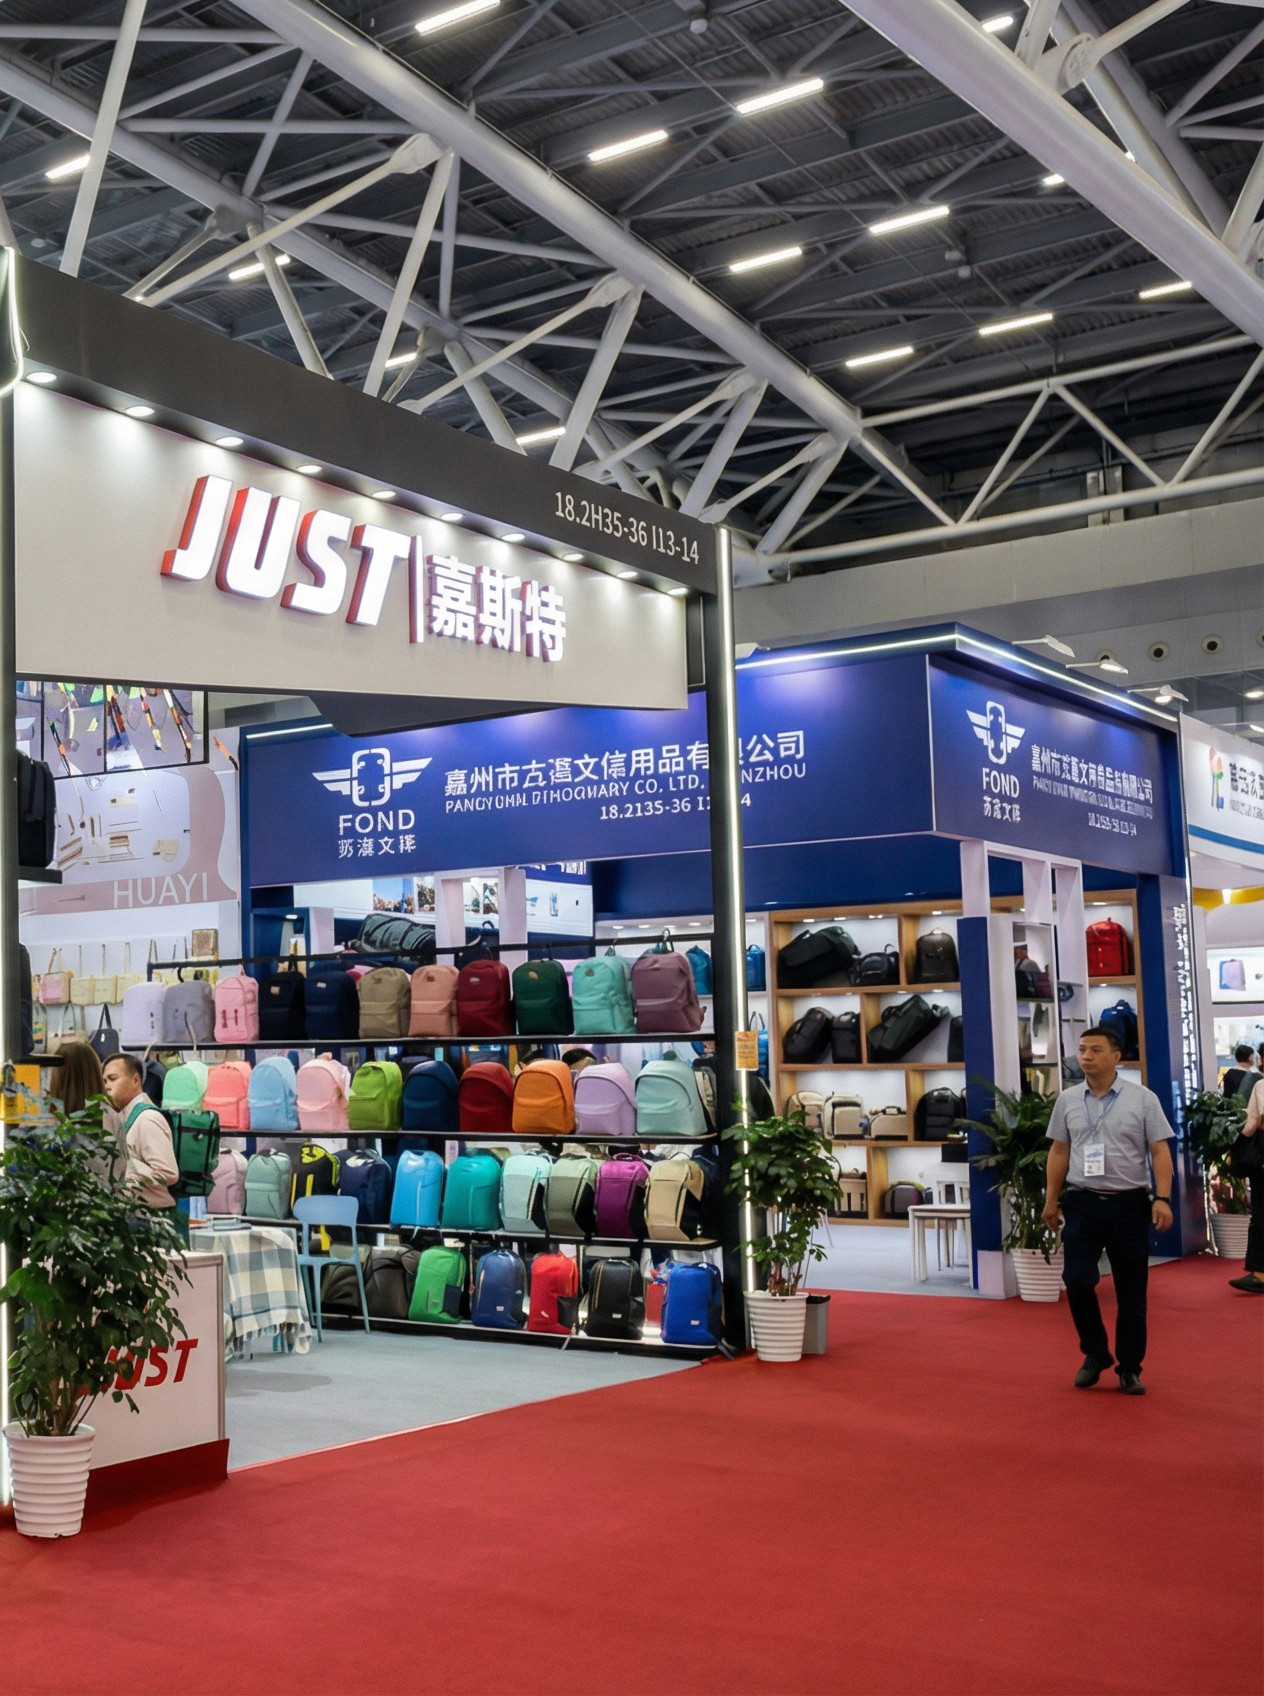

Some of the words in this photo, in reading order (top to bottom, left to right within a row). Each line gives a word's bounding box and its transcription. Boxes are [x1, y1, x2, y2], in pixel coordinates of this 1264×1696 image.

[554, 491, 648, 546] 18.2H35-36
[652, 525, 700, 565] I13-14
[160, 473, 410, 627] JUST
[426, 554, 567, 663] 嘉斯特
[740, 762, 807, 784] NZHOU
[982, 767, 1020, 799] FOND
[338, 809, 416, 836] FOND
[113, 872, 209, 909] HUAYI
